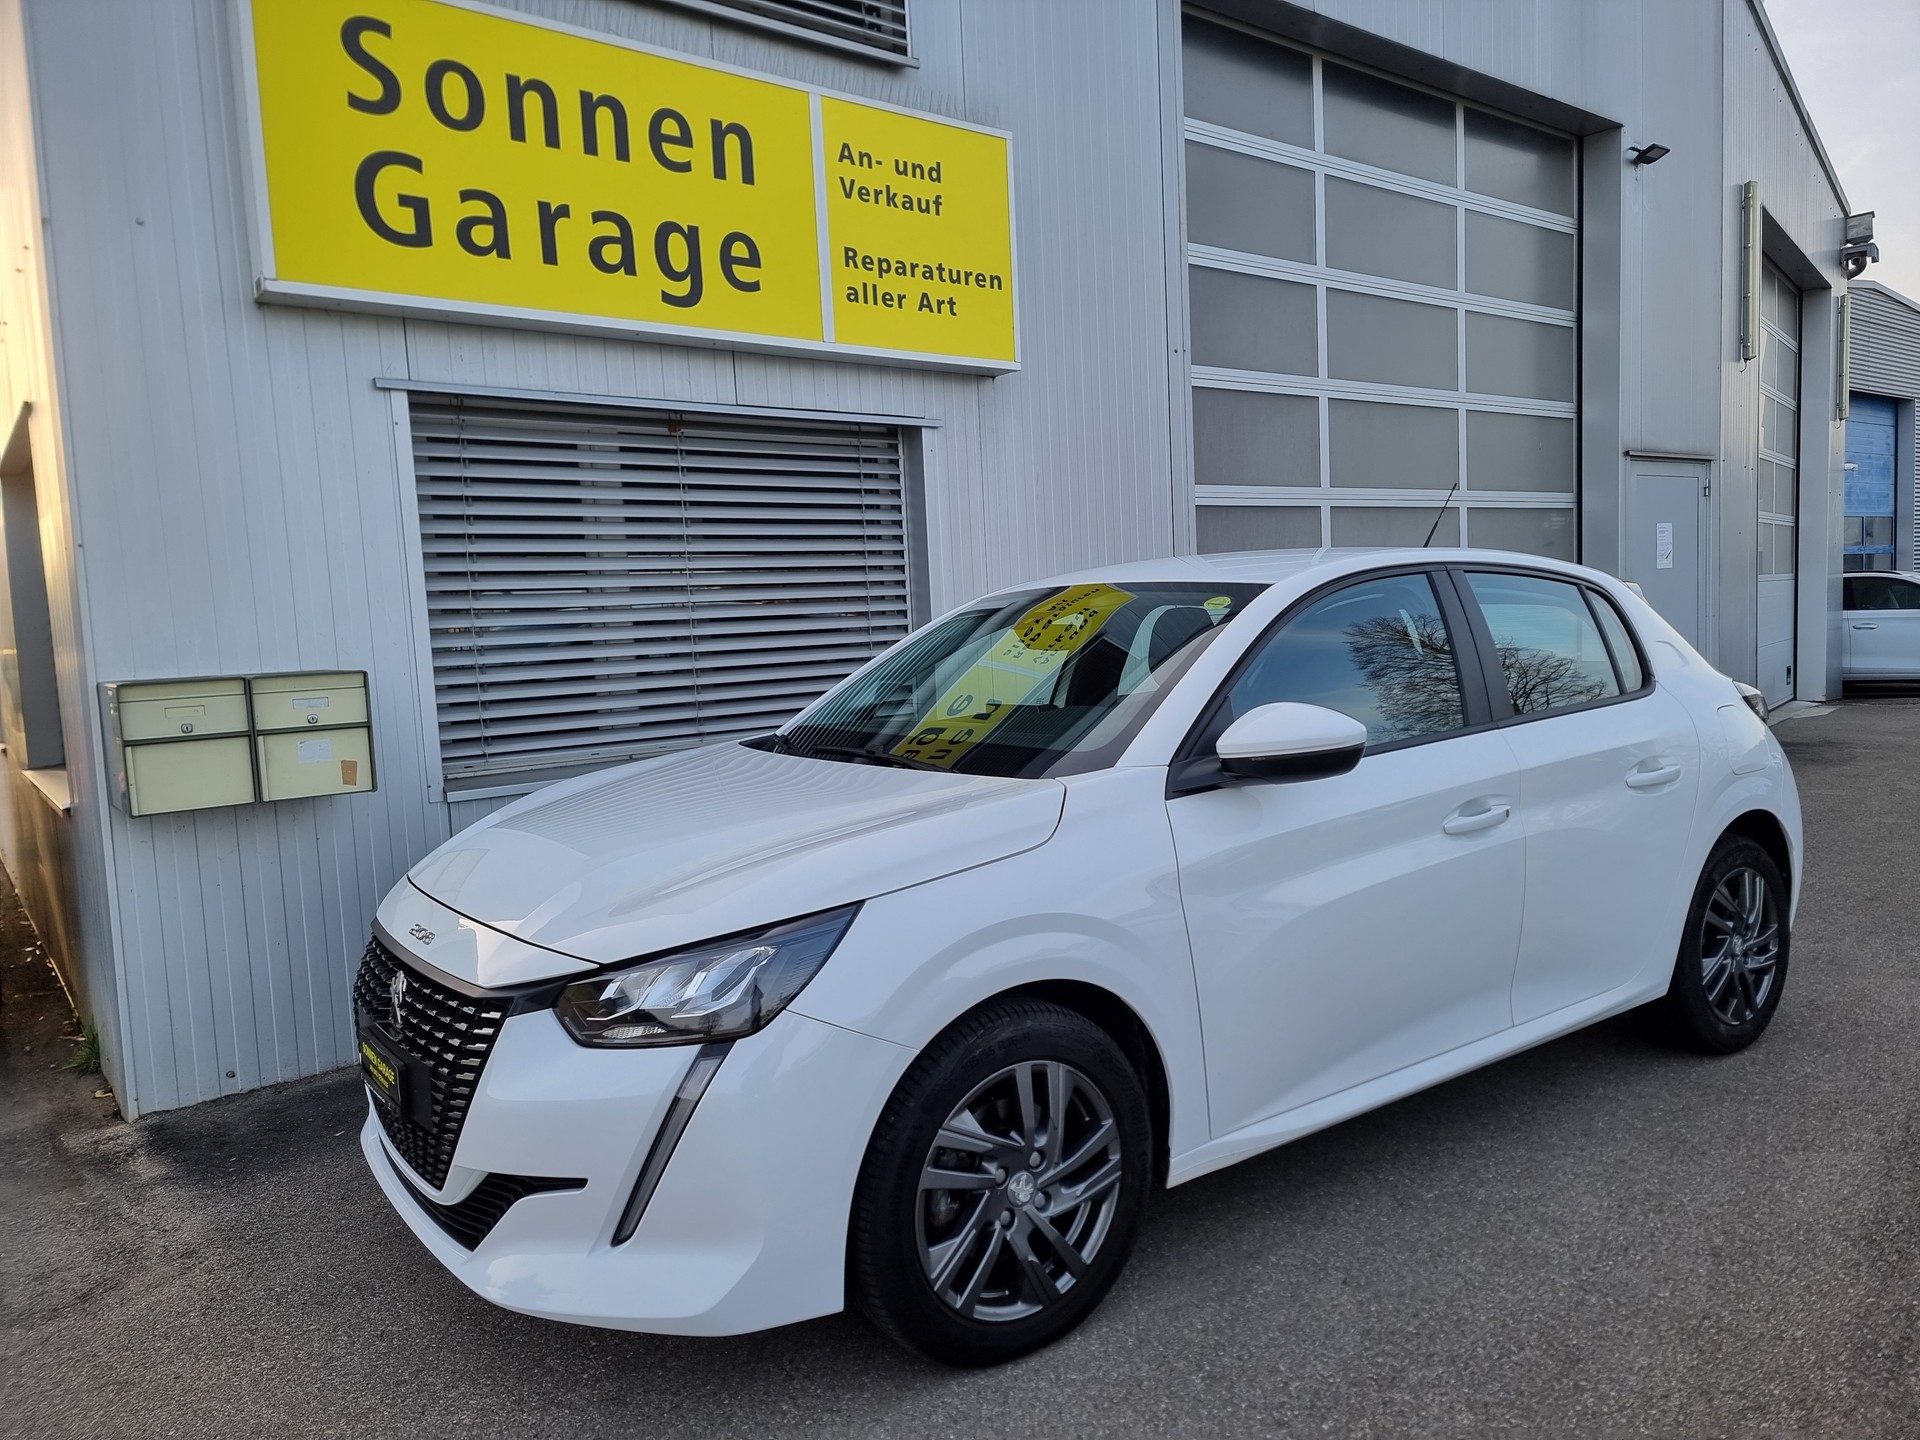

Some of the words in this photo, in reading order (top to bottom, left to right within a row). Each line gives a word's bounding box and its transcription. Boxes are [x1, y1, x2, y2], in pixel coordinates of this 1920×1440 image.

[341, 15, 755, 186] Sonnen
[838, 142, 883, 170] An-
[894, 158, 942, 184] und
[839, 176, 943, 217] Verkauf
[354, 150, 763, 309] Garage
[843, 246, 1003, 291] Reparaturen
[846, 281, 907, 310] aller
[917, 292, 957, 317] Art
[409, 923, 436, 945] 208
